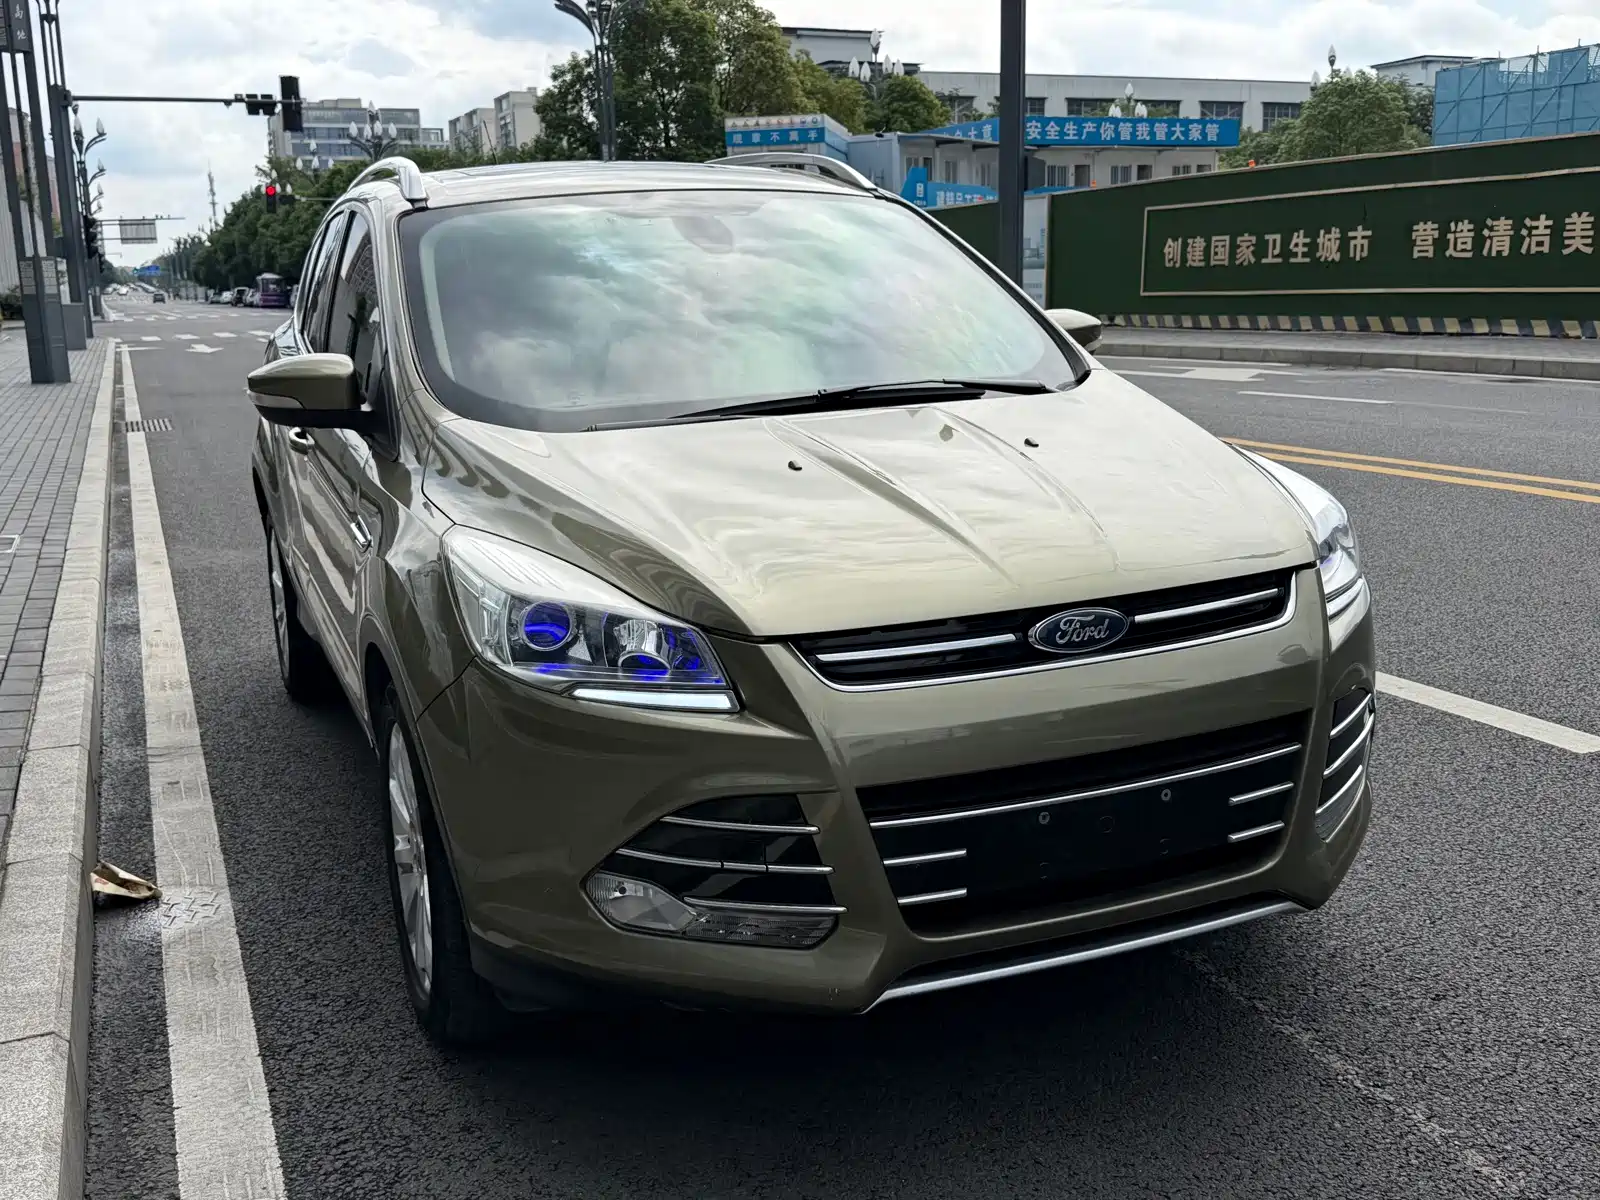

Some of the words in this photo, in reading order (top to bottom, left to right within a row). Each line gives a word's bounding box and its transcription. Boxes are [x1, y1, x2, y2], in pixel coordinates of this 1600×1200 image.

[1025, 120, 1220, 142] 安全生产你管我管大家管
[1162, 225, 1373, 268] 创建国家卫生城市
[1411, 211, 1595, 259] 营造清洁美
[1055, 614, 1110, 645] Ford
